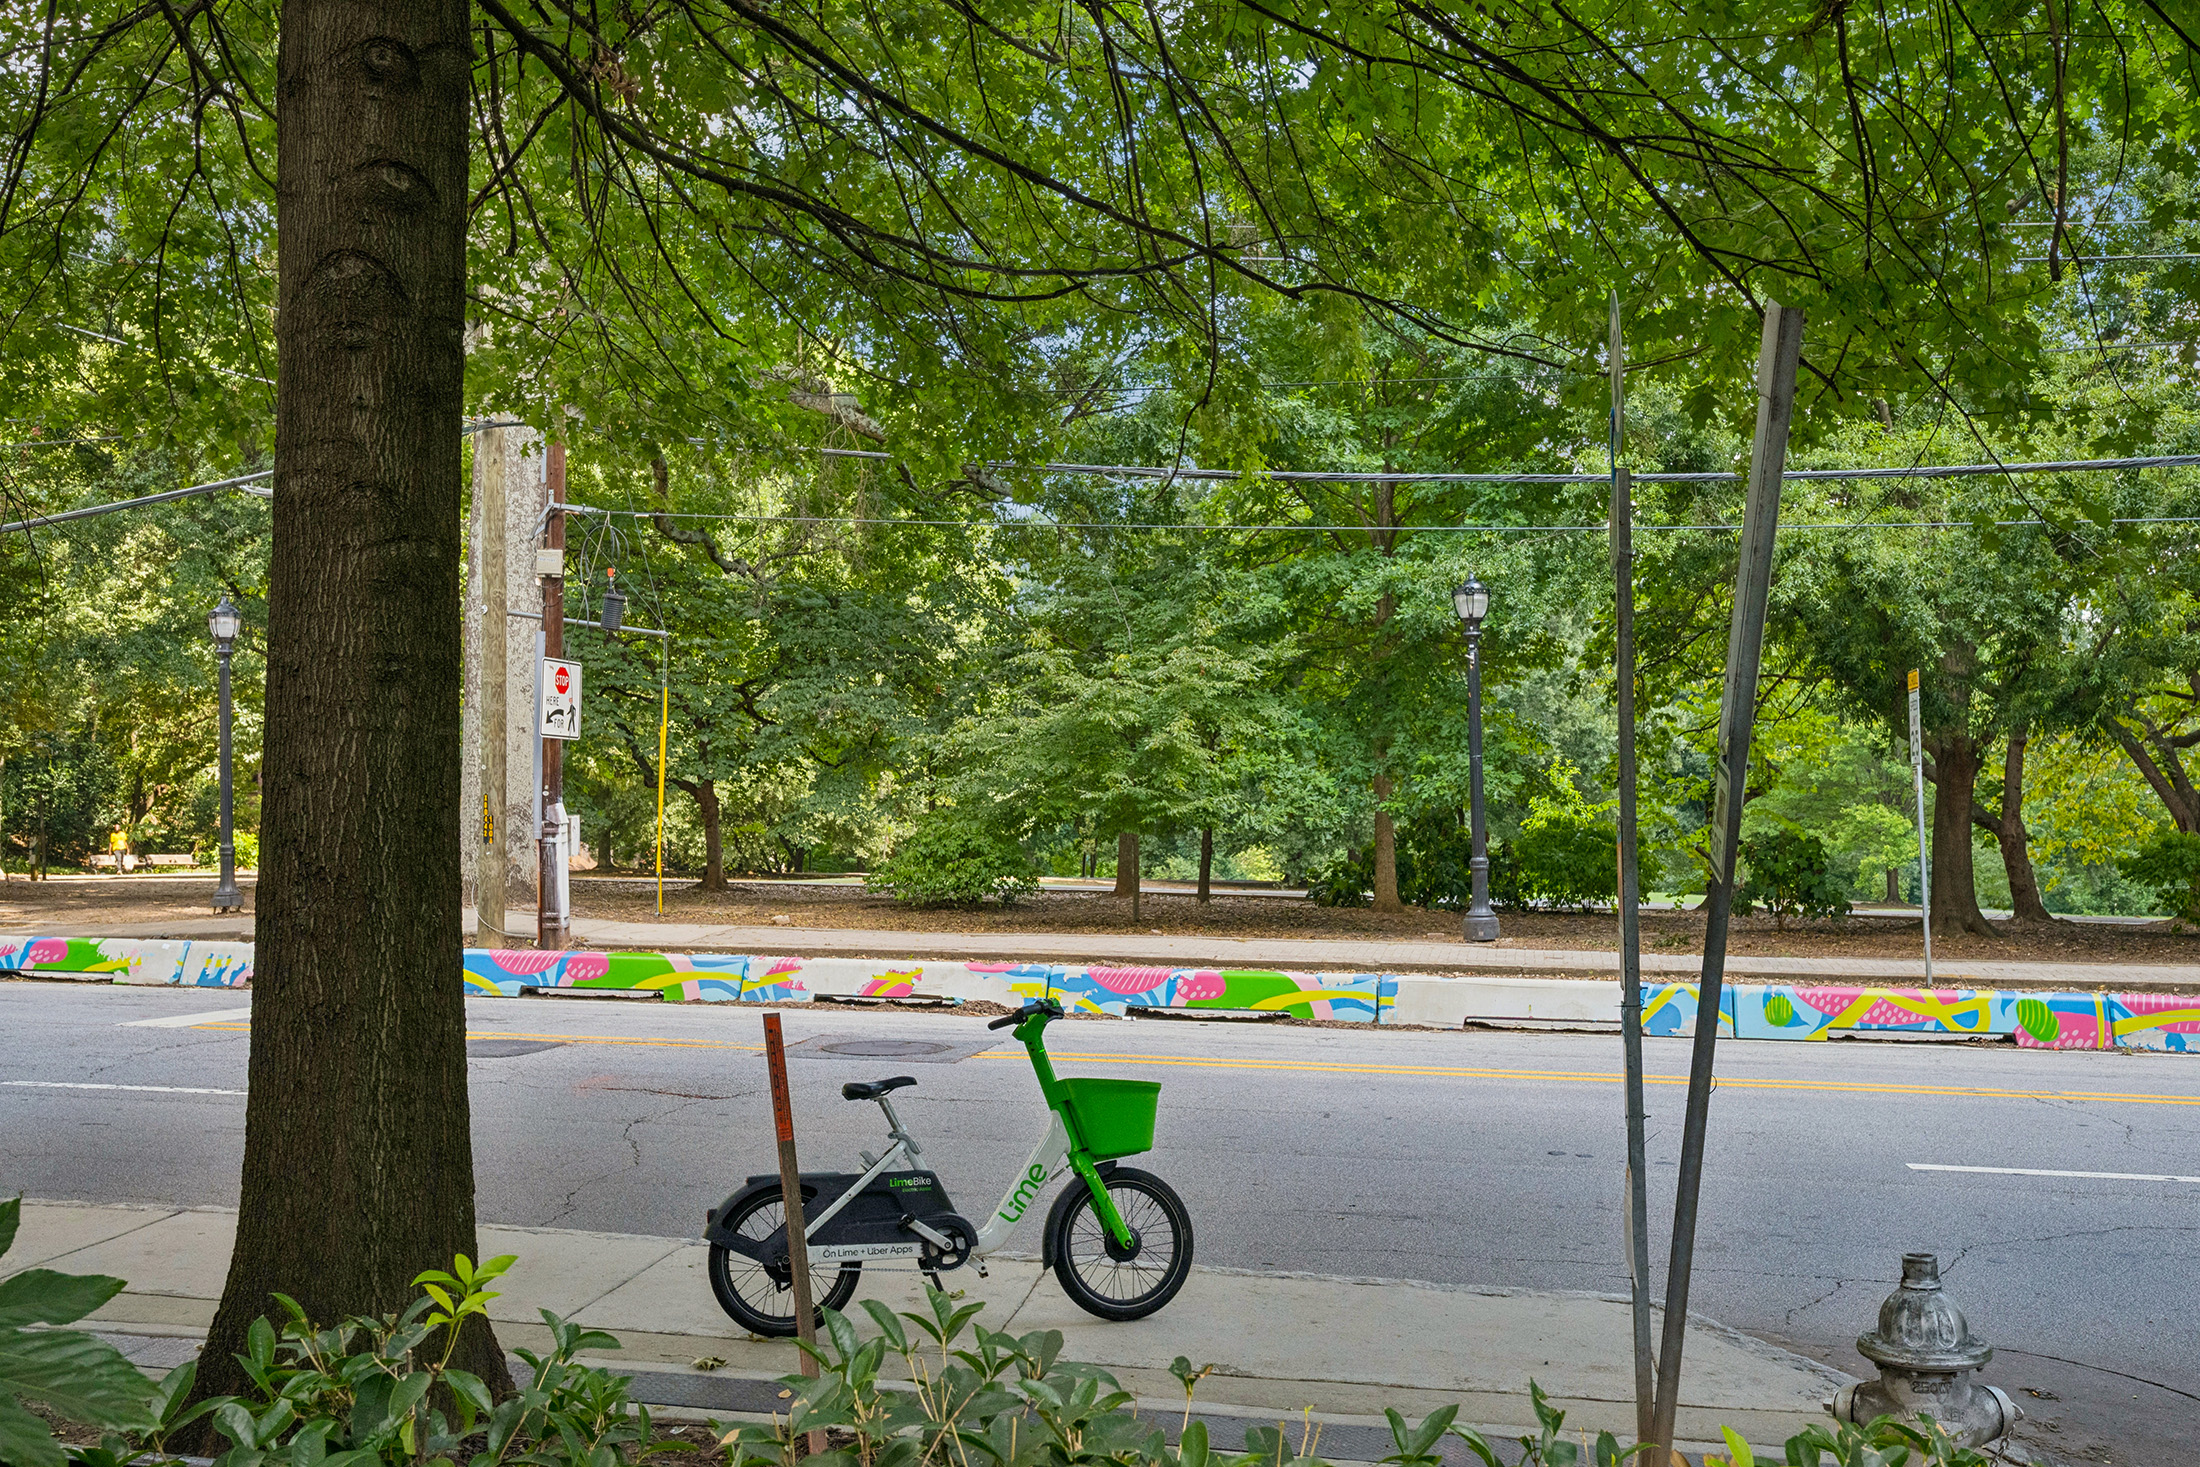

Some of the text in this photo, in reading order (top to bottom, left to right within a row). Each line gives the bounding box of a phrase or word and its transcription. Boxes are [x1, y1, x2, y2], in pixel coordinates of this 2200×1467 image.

[555, 674, 569, 686] STOP
[546, 695, 560, 706] HERE
[553, 718, 565, 728] FOR
[889, 1176, 932, 1187] LimeBike
[998, 1164, 1047, 1223] Lime
[823, 1249, 836, 1258] On
[838, 1248, 859, 1257] Lime
[867, 1247, 889, 1256] Uber
[890, 1246, 913, 1255] Apps
